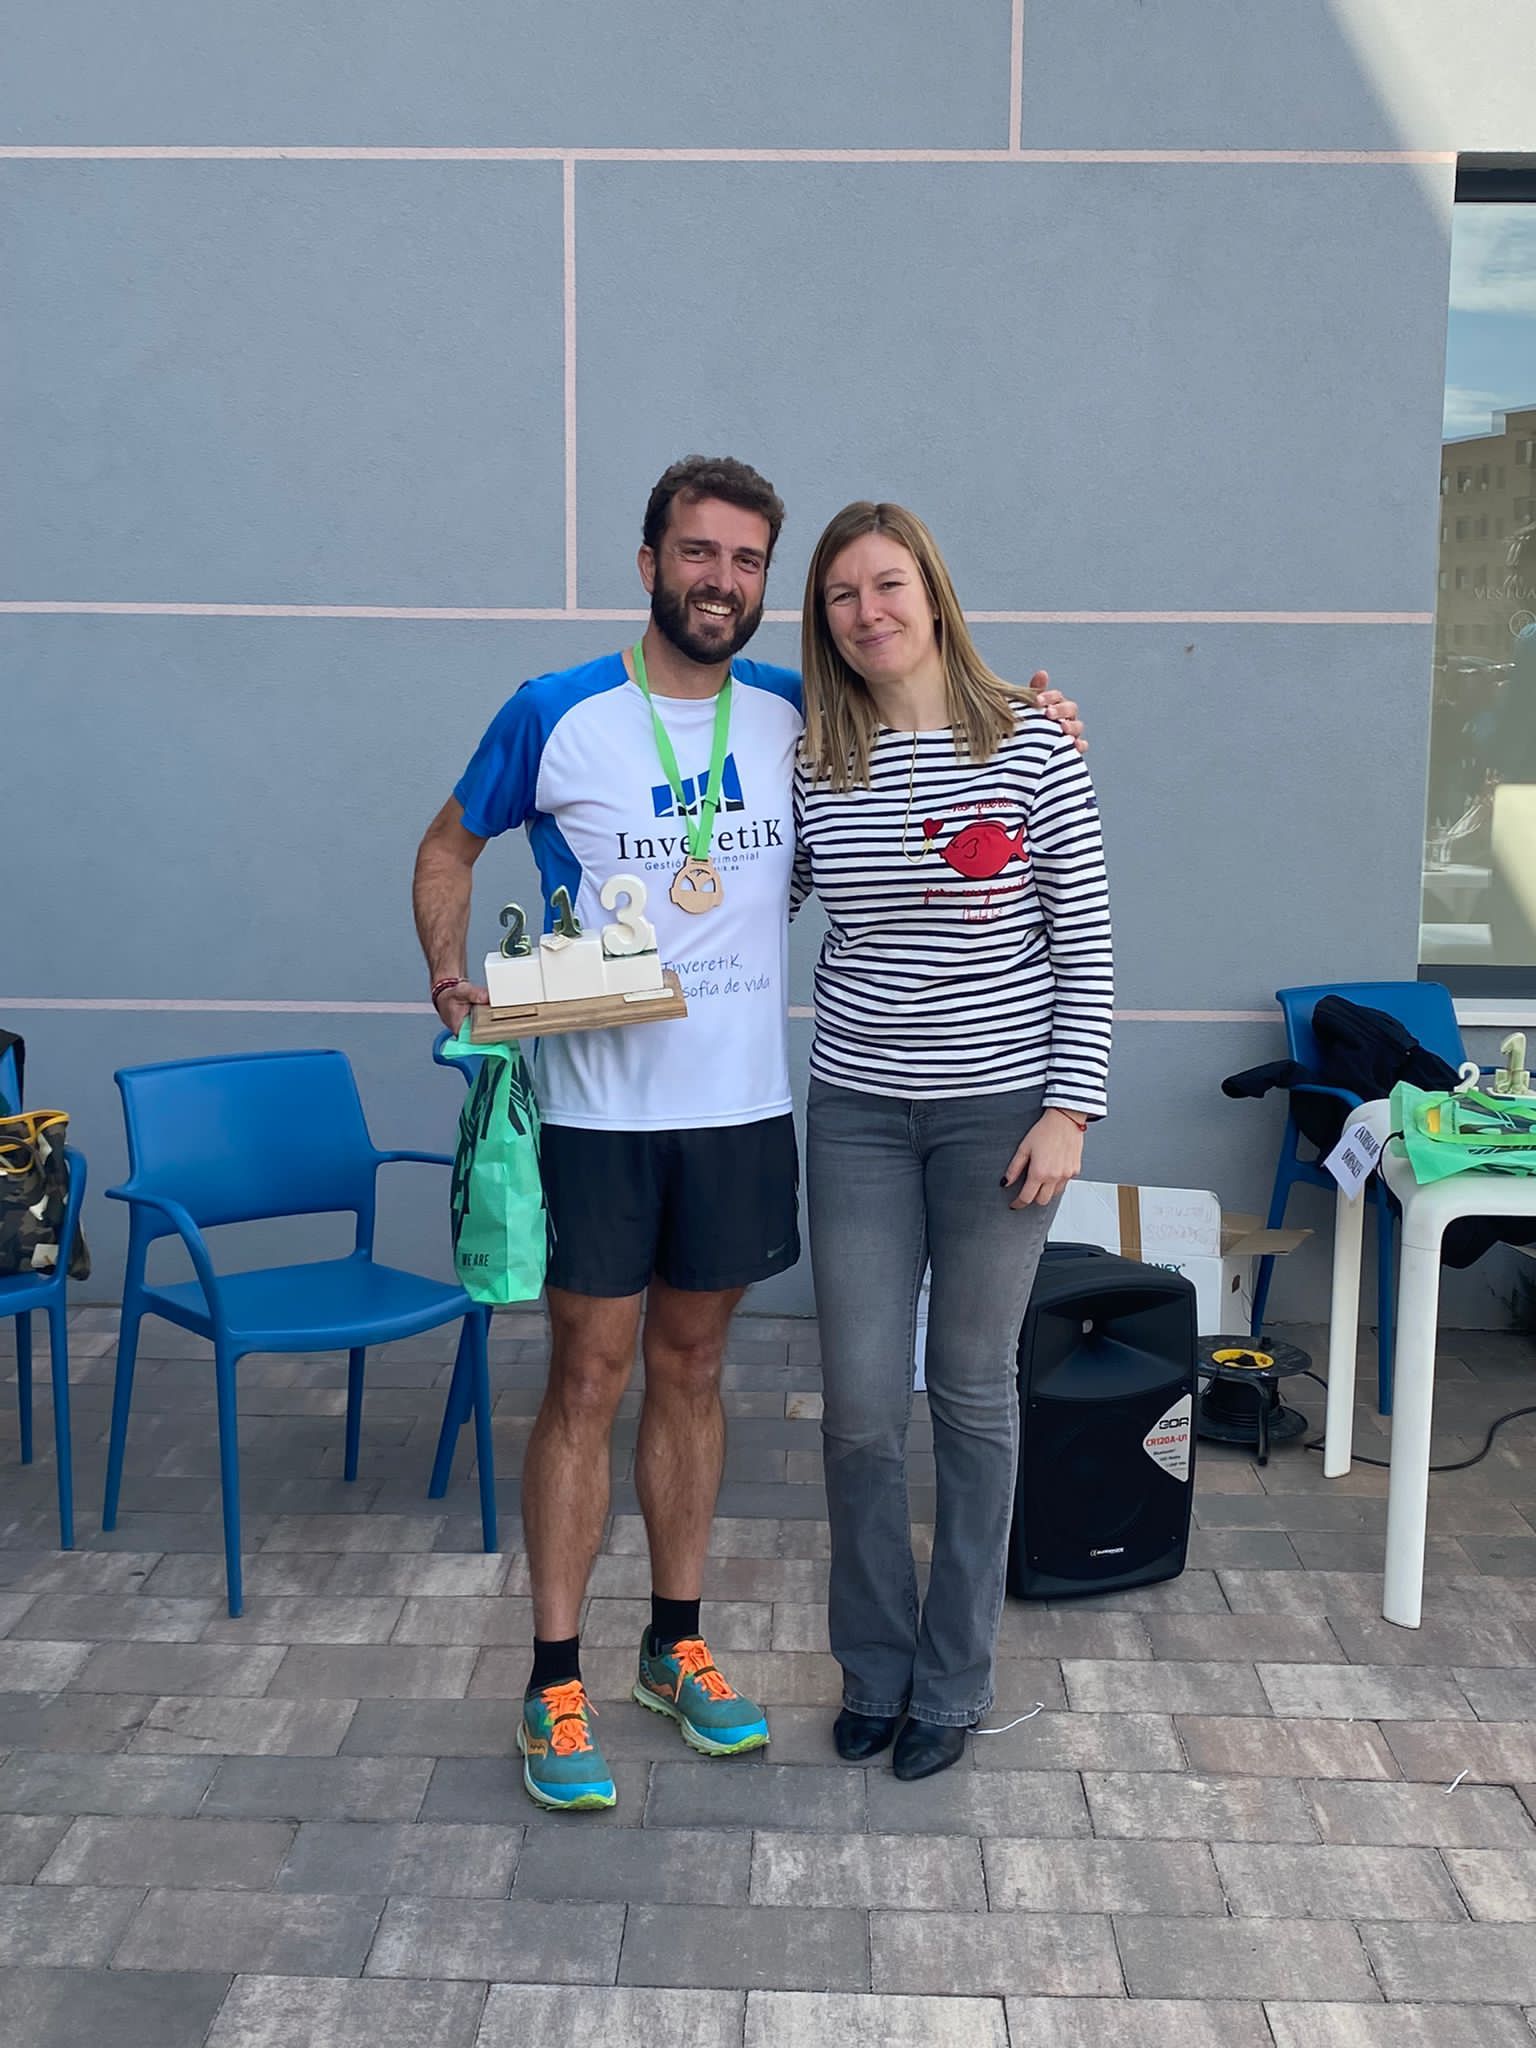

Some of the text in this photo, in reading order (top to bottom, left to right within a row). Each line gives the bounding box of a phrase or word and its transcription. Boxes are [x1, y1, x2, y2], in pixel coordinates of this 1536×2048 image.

[616, 819, 783, 860] InveetiK
[645, 852, 760, 871] Gestió rimonial
[500, 903, 532, 959] 2
[601, 874, 648, 956] 3
[725, 977, 740, 994] de
[745, 973, 770, 993] vida
